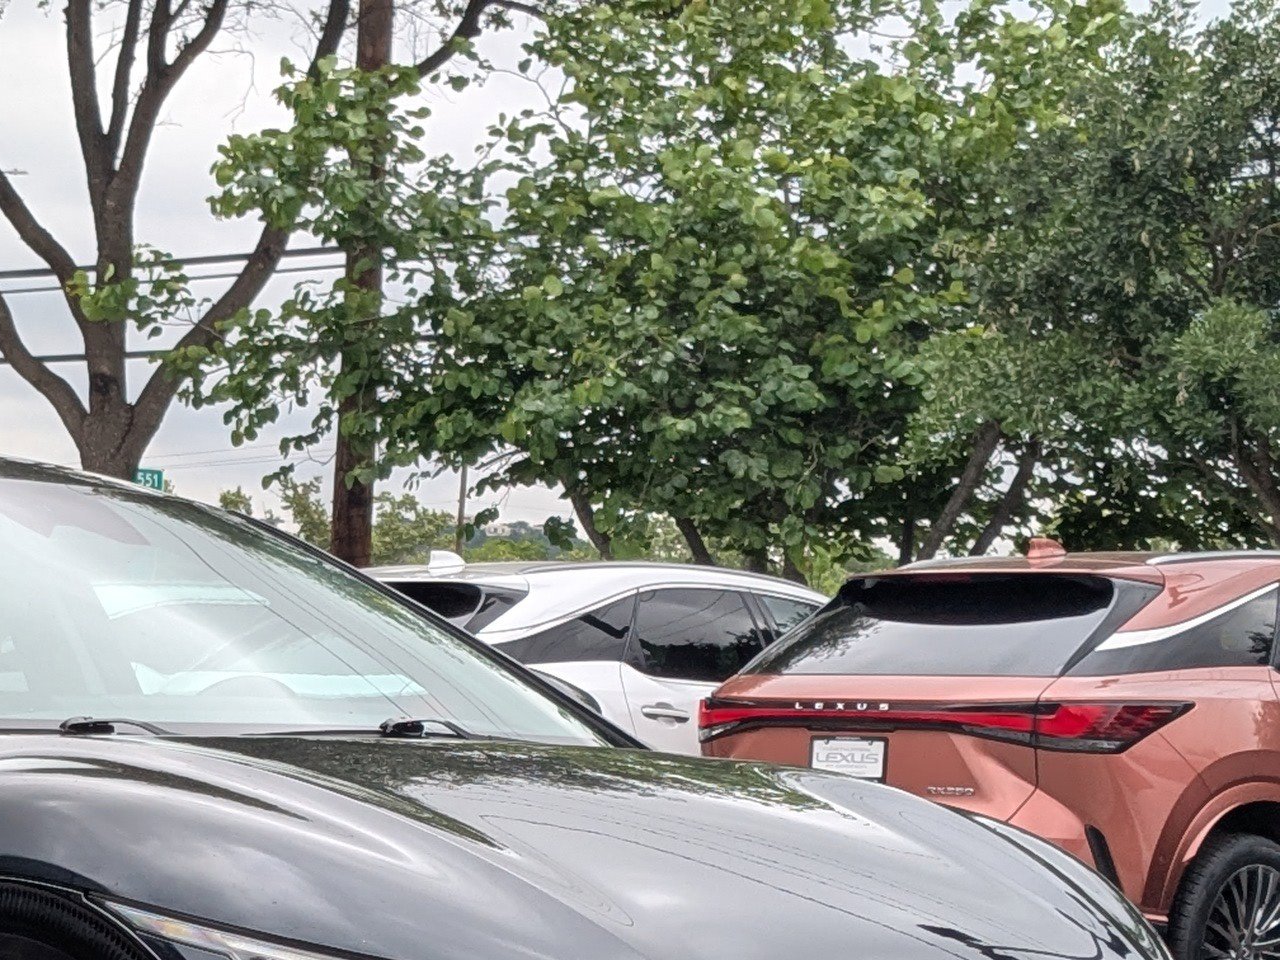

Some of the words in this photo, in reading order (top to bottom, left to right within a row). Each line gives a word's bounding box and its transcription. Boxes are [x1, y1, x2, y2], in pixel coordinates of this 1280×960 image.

[137, 473, 158, 488] 551
[795, 702, 889, 711] LEXUS
[816, 752, 880, 764] LEXUS
